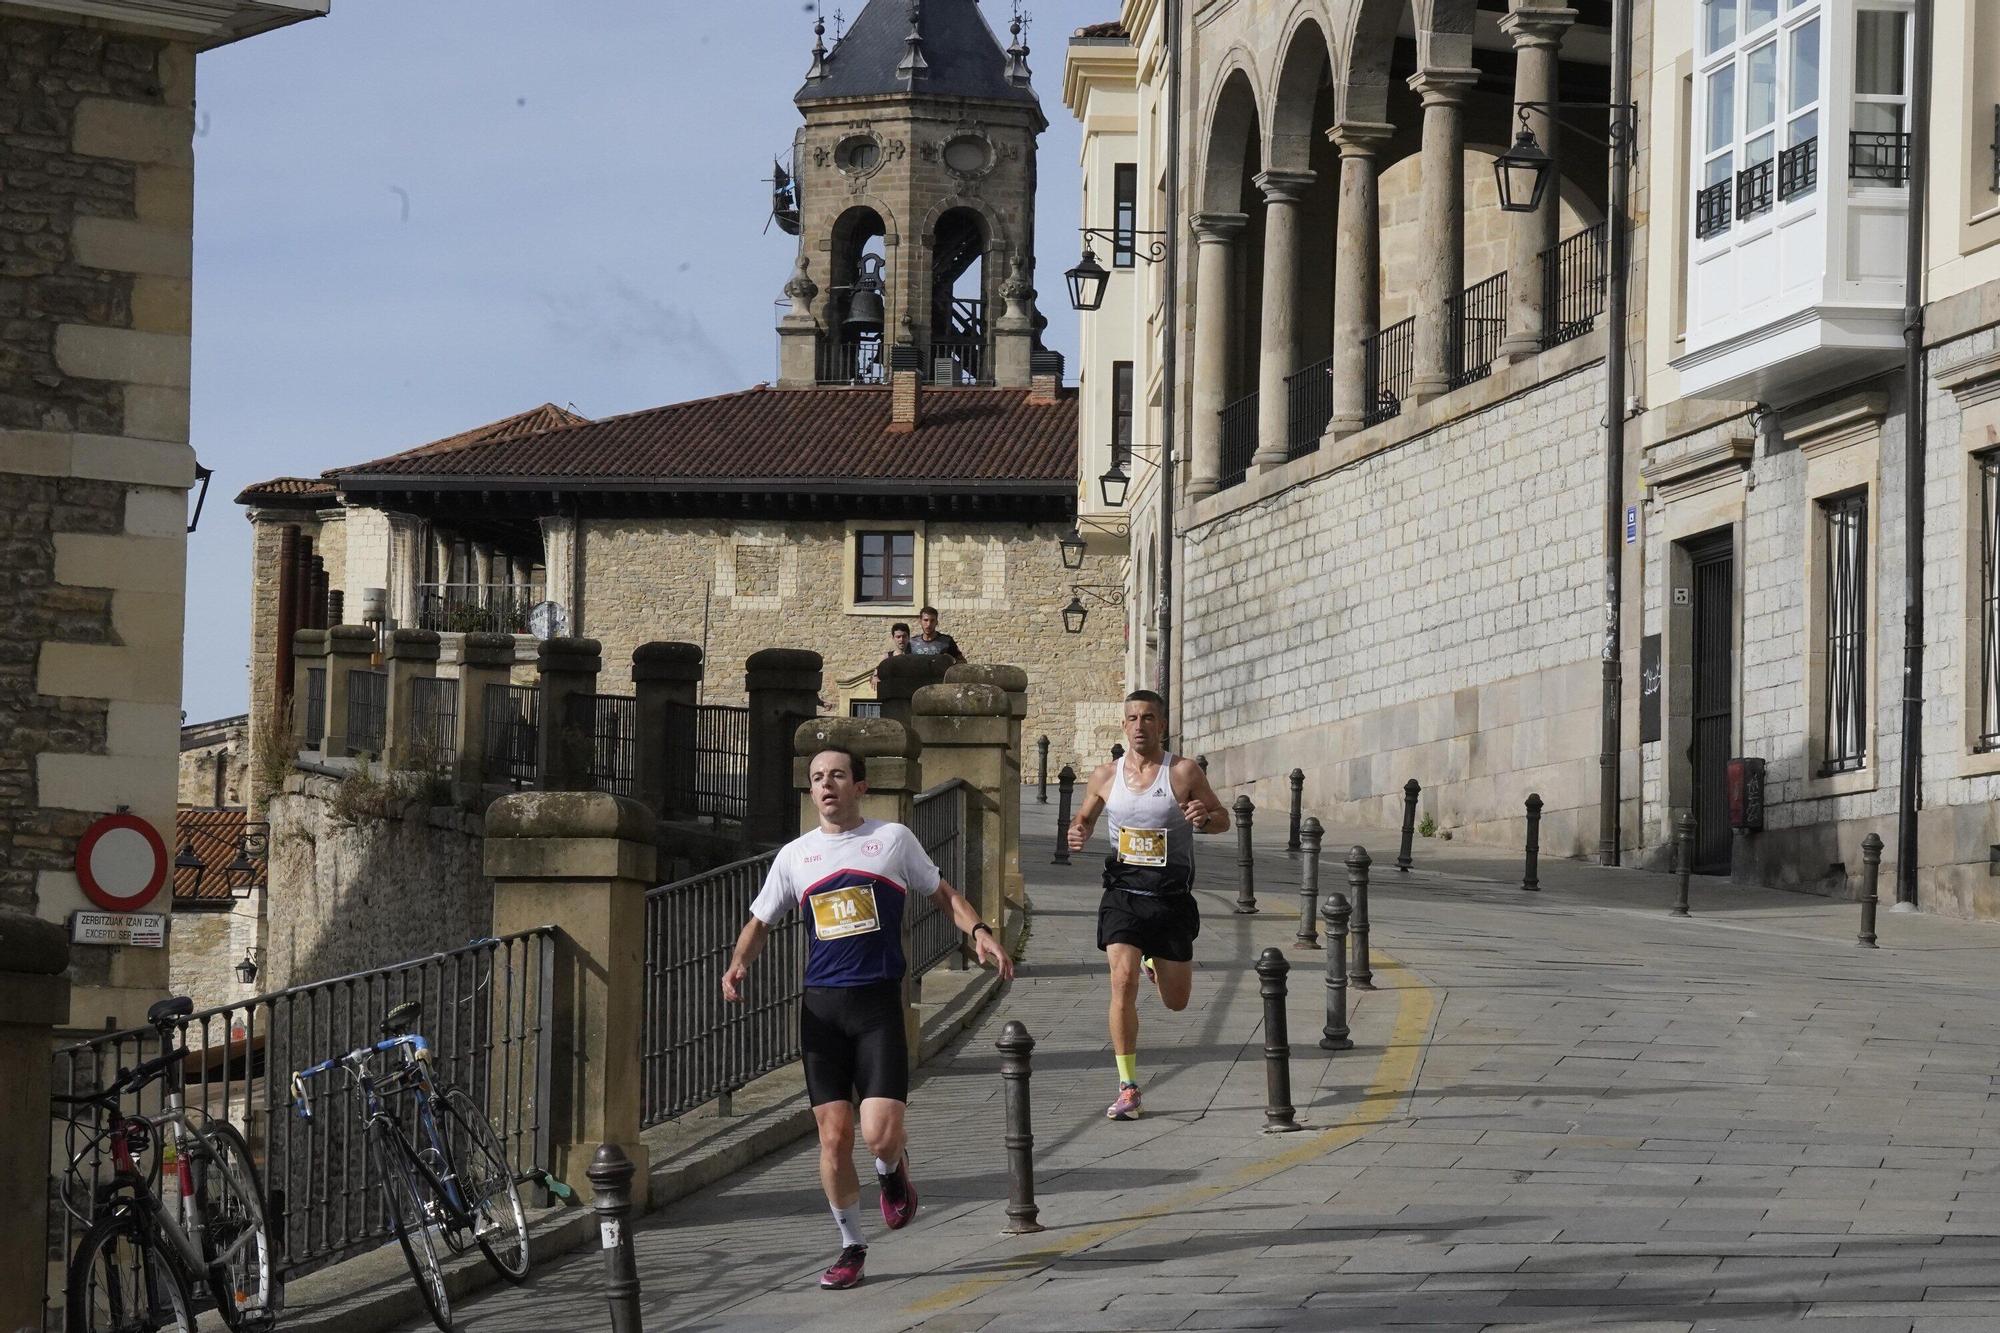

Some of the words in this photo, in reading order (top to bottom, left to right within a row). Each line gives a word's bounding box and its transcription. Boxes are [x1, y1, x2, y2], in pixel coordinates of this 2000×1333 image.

[1128, 837, 1153, 852] 435
[831, 899, 857, 920] 114
[81, 915, 123, 927] ZERBITZUAK
[126, 917, 142, 927] IZAN
[144, 918, 159, 928] EZIK
[85, 928, 117, 939] EXCEPTO
